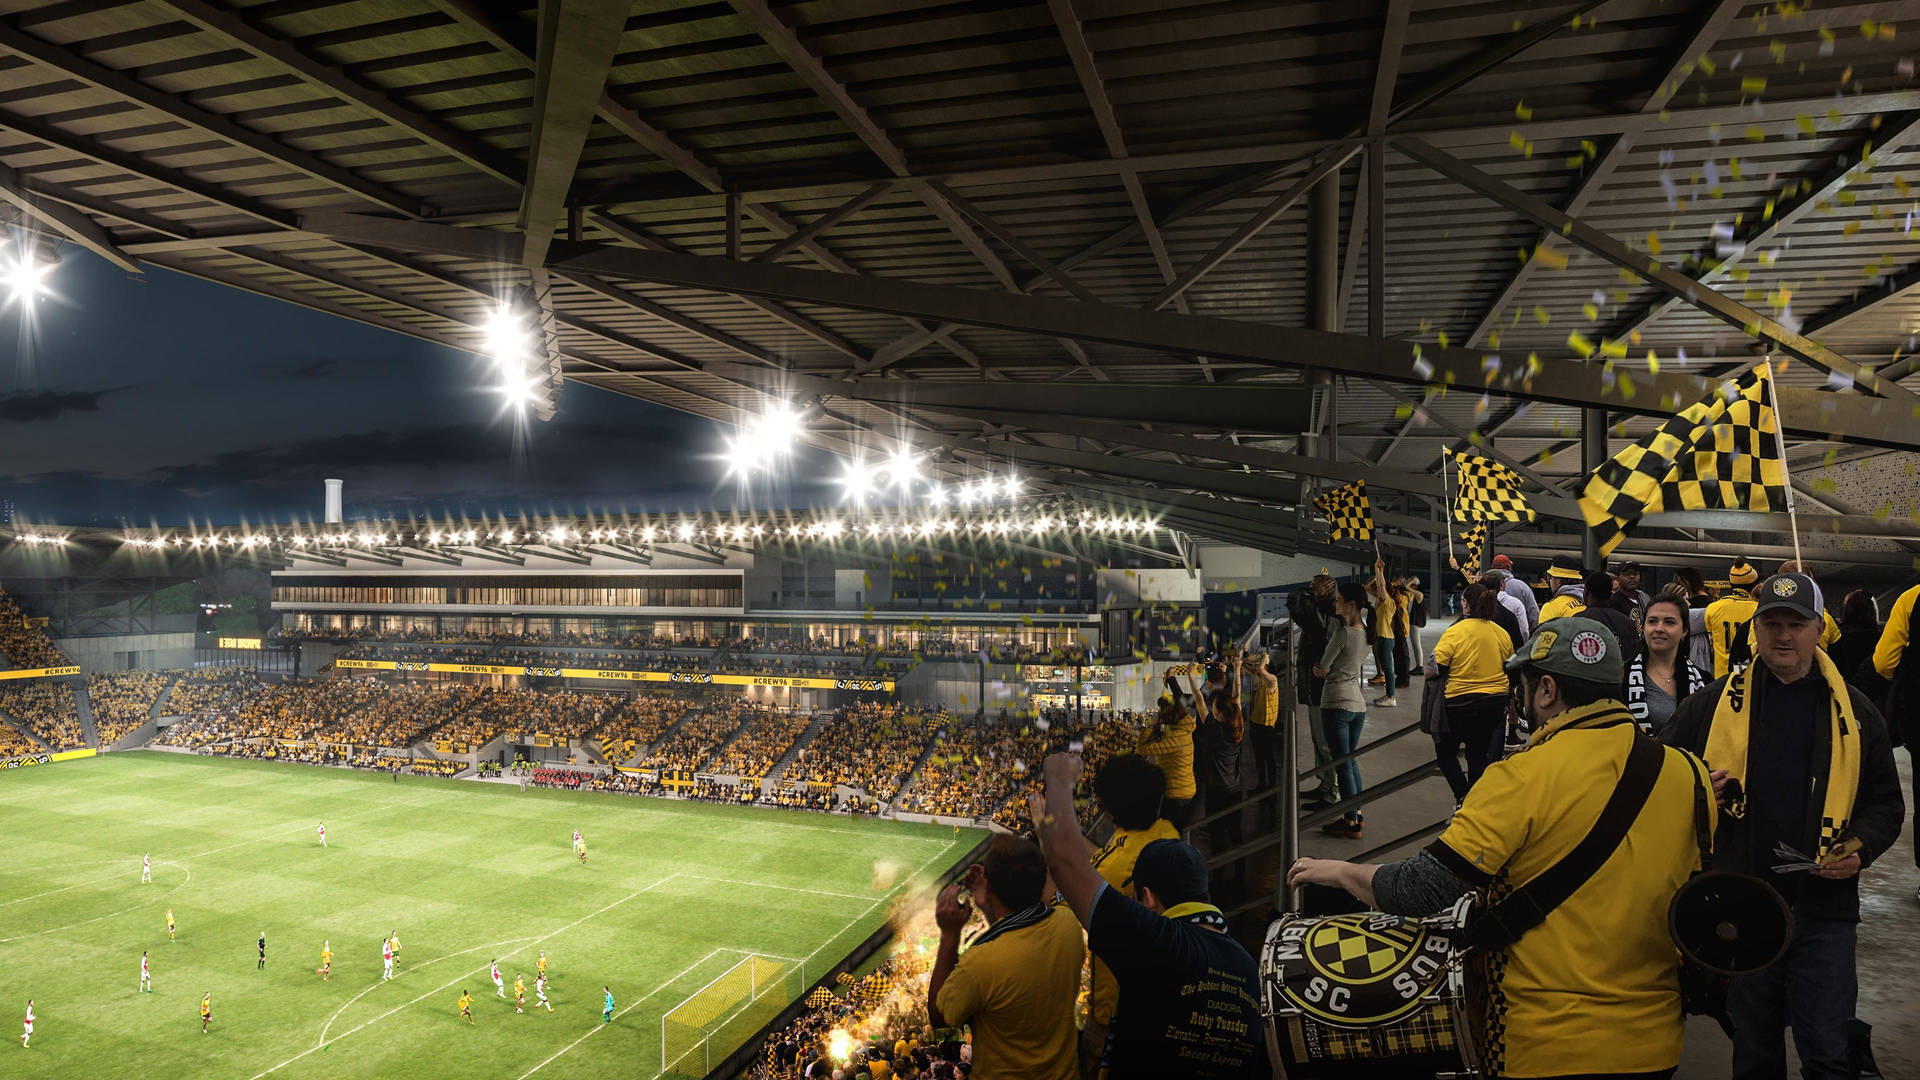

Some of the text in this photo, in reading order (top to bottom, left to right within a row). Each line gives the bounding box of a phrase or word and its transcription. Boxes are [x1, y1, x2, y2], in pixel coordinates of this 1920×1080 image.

[44, 667, 80, 675] #CREW96
[461, 665, 488, 673] #CREW96
[598, 671, 628, 679] #CREW96
[753, 677, 788, 686] #CREW96
[1303, 976, 1351, 1014] SC
[1190, 1011, 1248, 1037] Ruby Tuesday
